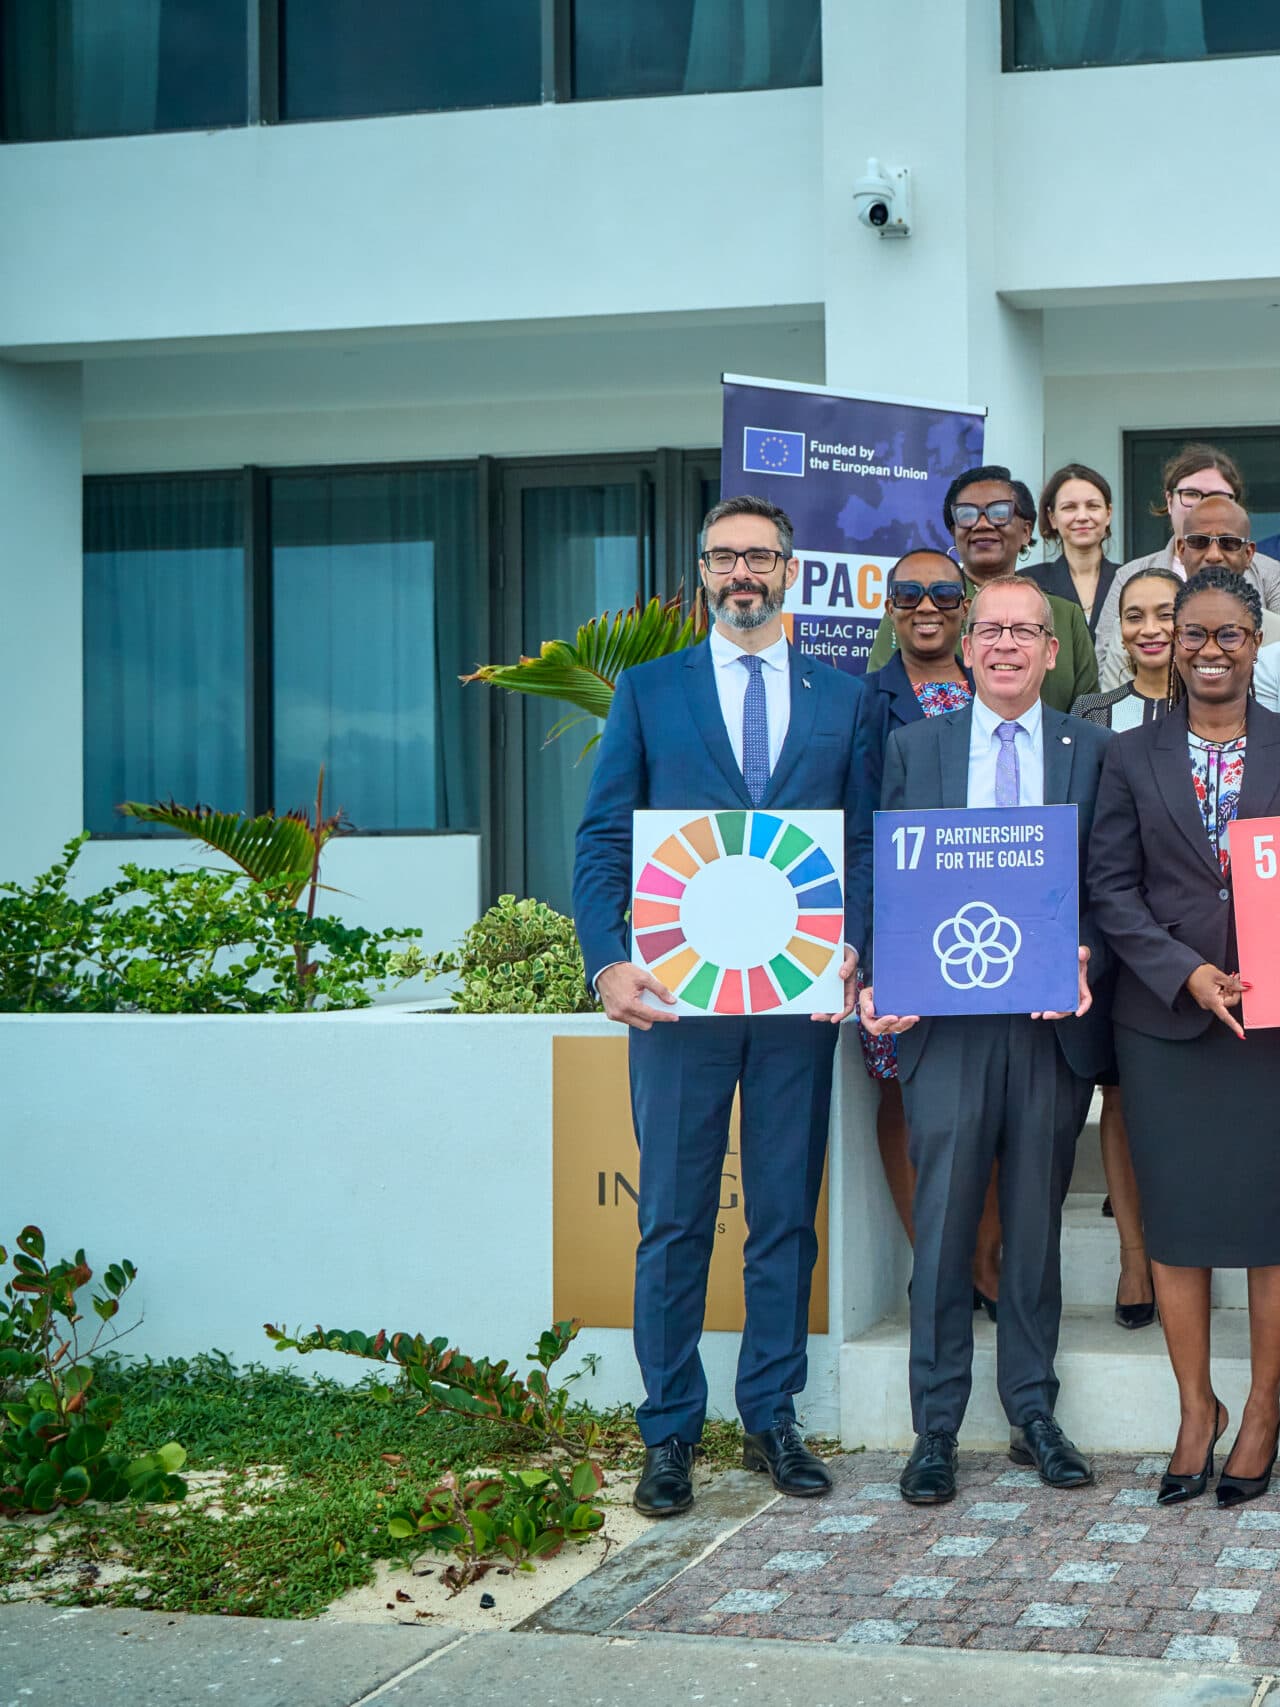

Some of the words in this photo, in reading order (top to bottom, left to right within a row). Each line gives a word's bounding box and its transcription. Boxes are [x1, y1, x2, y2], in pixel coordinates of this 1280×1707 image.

[810, 440, 856, 456] Funded
[860, 446, 875, 461] by
[809, 457, 829, 470] the
[832, 459, 890, 476] European
[893, 465, 928, 480] Union
[802, 560, 894, 609] PAC
[800, 622, 853, 639] EU-LAC
[851, 646, 872, 657] an
[936, 825, 1044, 845] PARTNERSHIPS
[892, 826, 926, 870] 17
[1253, 834, 1277, 879] 5
[936, 852, 963, 870] FOR
[968, 850, 994, 868] THE
[997, 849, 1044, 868] GOALS
